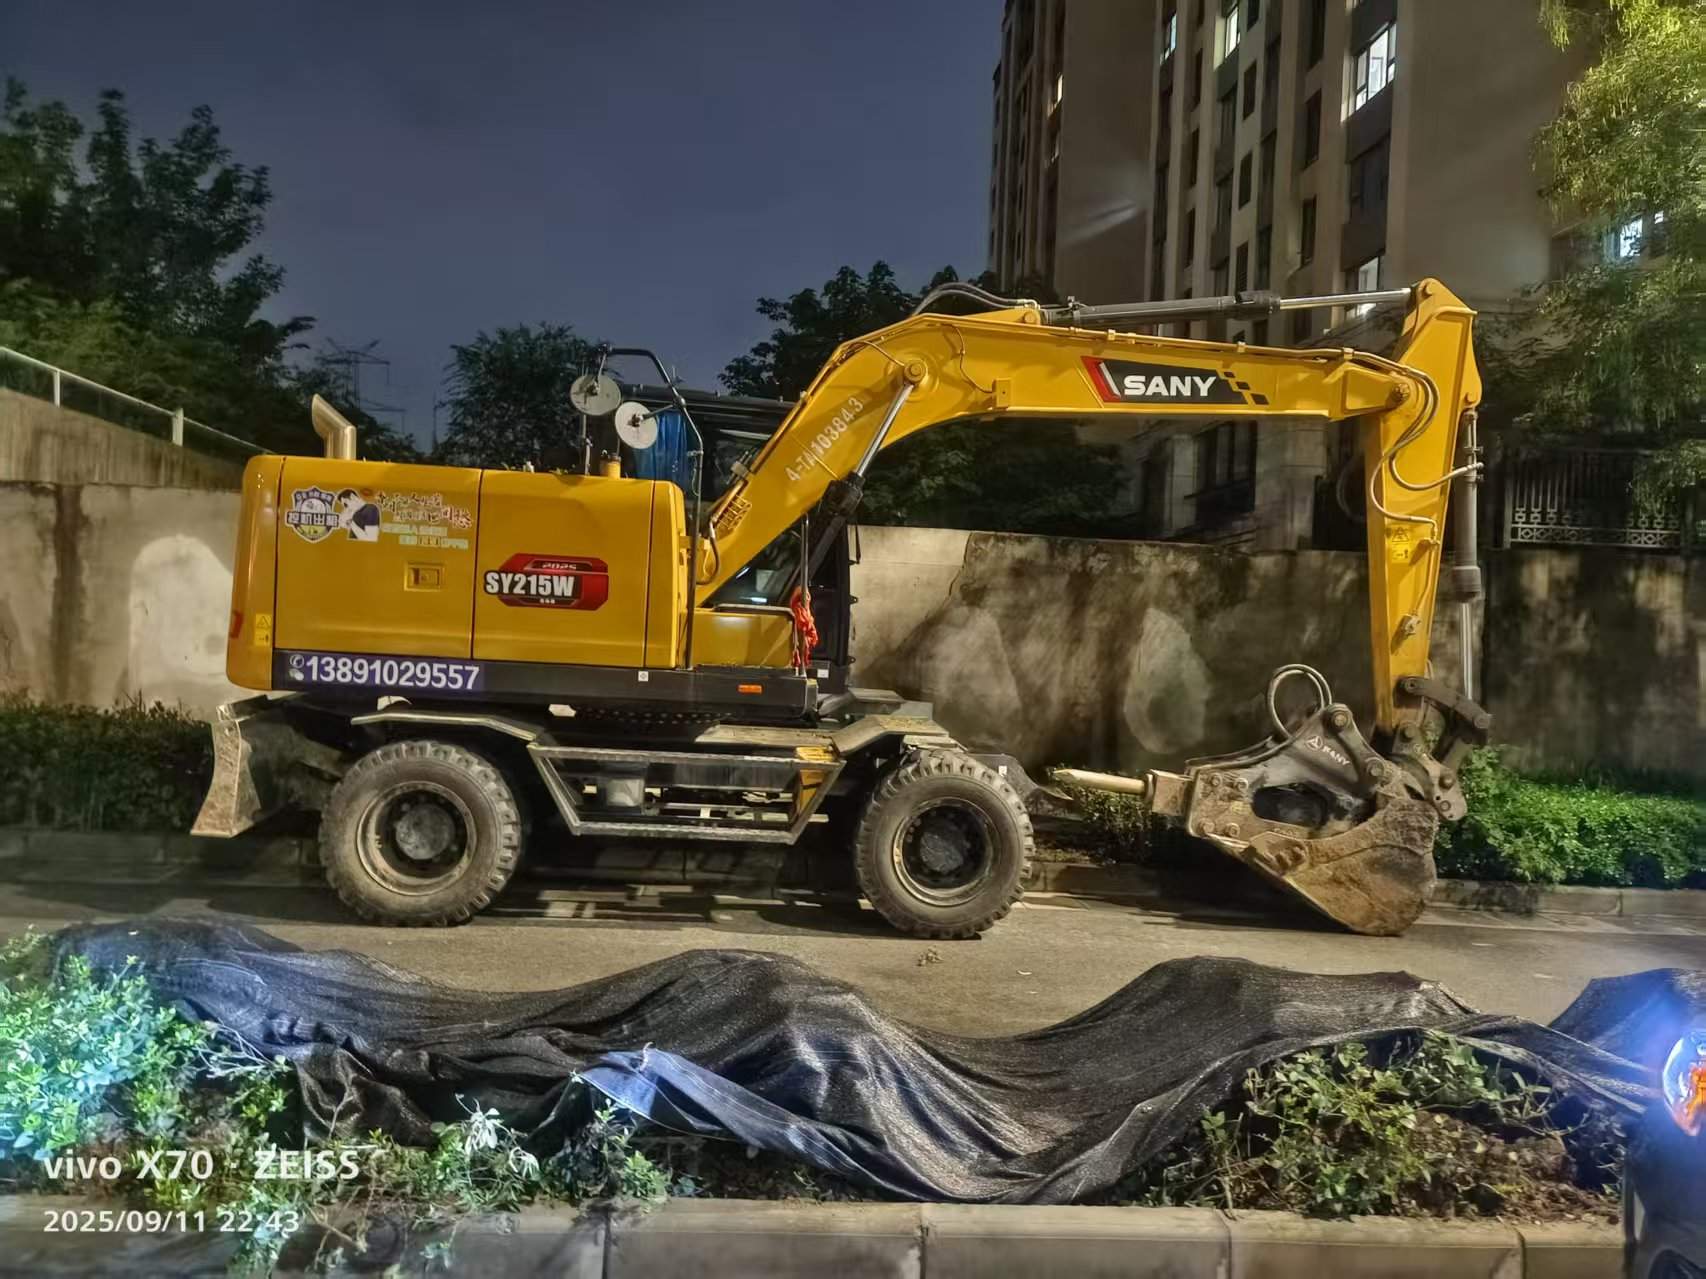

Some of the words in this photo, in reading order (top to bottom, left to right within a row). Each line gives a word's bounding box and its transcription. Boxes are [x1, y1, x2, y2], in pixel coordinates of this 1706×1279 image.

[1123, 374, 1217, 398] SANY
[485, 571, 575, 597] SY215W
[306, 656, 480, 690] 13891029557
